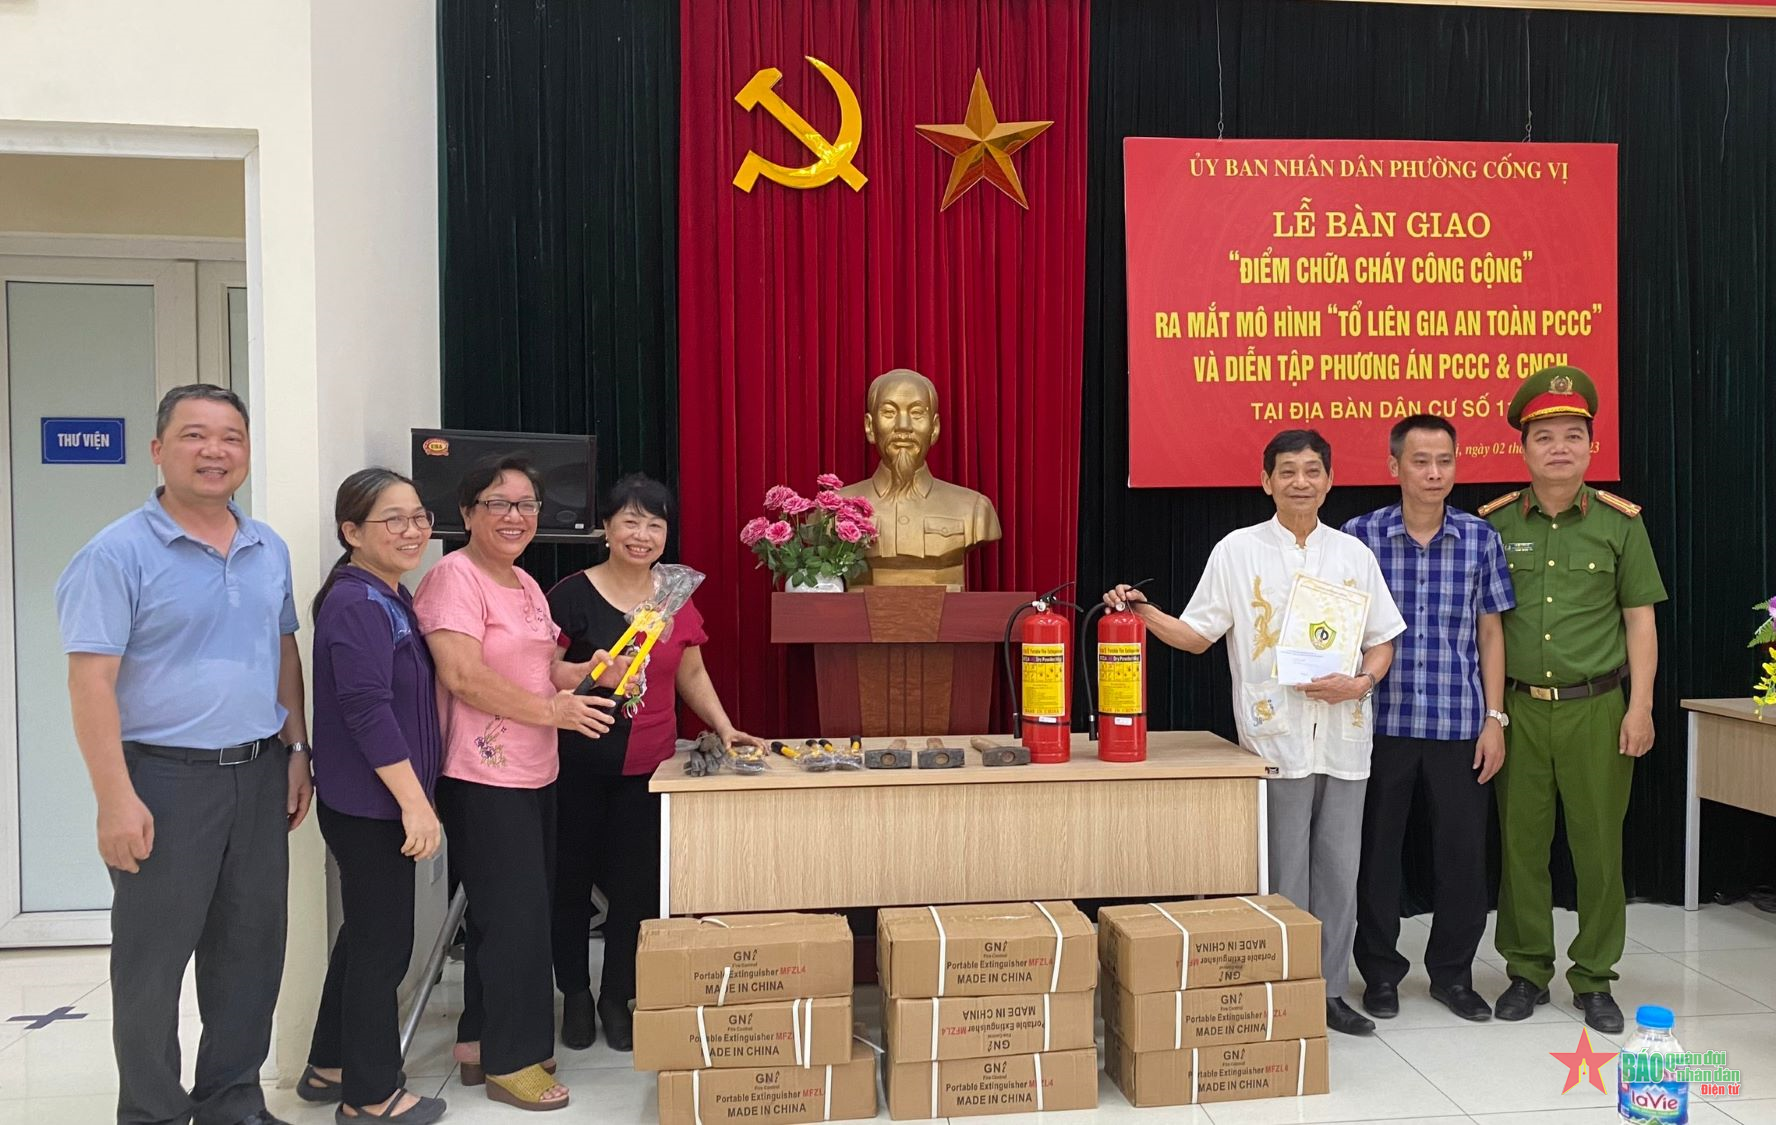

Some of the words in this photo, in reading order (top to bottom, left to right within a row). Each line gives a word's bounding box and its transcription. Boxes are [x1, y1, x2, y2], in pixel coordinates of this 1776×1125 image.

[1190, 153, 1219, 176] ỦY
[1225, 159, 1268, 176] BAN
[1274, 154, 1334, 176] NHÂN
[1340, 154, 1384, 176] DÂN
[1390, 156, 1476, 178] PHƯỜNG
[1483, 153, 1541, 178] CỐNG
[1548, 162, 1568, 184] VỊ
[1273, 197, 1316, 237] LỄ
[1326, 204, 1396, 237] BÀN
[1407, 212, 1490, 238] GIAO
[1296, 252, 1349, 283] CHỮA
[1355, 252, 1405, 283] CHÁY
[1412, 252, 1464, 283] CÔNG
[1156, 312, 1181, 338] RA
[1188, 302, 1230, 338] MẮT
[1236, 306, 1267, 338] MÔ
[1274, 305, 1321, 337] HÌNH
[1368, 305, 1410, 336] LIÊN
[1416, 310, 1448, 336] GIA
[1454, 310, 1480, 336] AN
[1487, 305, 1536, 336] TOÀN
[1194, 350, 1219, 382] VÀ
[1225, 346, 1271, 381] DIỄN
[1278, 350, 1314, 387] TẬP
[1320, 352, 1399, 380] PHƯƠNG
[1406, 348, 1433, 379] ÁN
[1439, 353, 1490, 379] PCCC
[1496, 353, 1510, 380] &
[1251, 403, 1283, 424] TẠI
[1290, 402, 1324, 423] ĐỊA
[1330, 397, 1372, 418] BÀN
[1380, 396, 1421, 418] DÂN
[1429, 398, 1457, 417] CƯ
[1462, 393, 1490, 417] SỐ
[58, 432, 81, 447] THƯ
[83, 431, 109, 450] VIỆN
[1466, 443, 1490, 458] ngày
[1492, 442, 1505, 455] 02
[1196, 942, 1225, 953] CHINA
[1228, 941, 1237, 951] IN
[1240, 940, 1266, 950] MADE
[947, 961, 978, 970] Portable
[980, 959, 1026, 969] Extinguisher
[1201, 955, 1245, 964] Extinguisher
[729, 968, 778, 979] Extinguisher
[958, 974, 986, 984] MADE
[988, 973, 998, 983] IN
[1001, 972, 1032, 982] CHINA
[706, 984, 735, 994] MAE
[738, 983, 749, 993] IN
[751, 981, 784, 992] CHINA
[963, 1009, 993, 1020] CHINA
[995, 1008, 1006, 1018] IN
[1008, 1006, 1036, 1016] MADE
[1186, 1014, 1216, 1023] Portable
[1218, 1012, 1262, 1021] Extinguisher
[968, 1022, 1014, 1033] Extinguisher
[1196, 1027, 1223, 1036] MADE
[1225, 1026, 1235, 1035] IN
[1237, 1024, 1266, 1033] CHINA
[724, 1032, 774, 1044] Extinguisher
[733, 1047, 744, 1056] IN
[747, 1046, 780, 1056] CHINA
[1219, 1067, 1264, 1077] Extinguisher
[946, 1083, 978, 1092] Portable
[980, 1081, 1027, 1092] Extinguisher
[1198, 1082, 1226, 1092] MADE
[1227, 1081, 1237, 1090] IN
[1239, 1079, 1269, 1089] CHINA
[716, 1094, 749, 1103] Portable
[751, 1091, 800, 1101] Extinguisher
[802, 1088, 824, 1097] MFZL
[957, 1095, 986, 1105] MADE
[988, 1095, 998, 1104] IN
[1000, 1093, 1032, 1104] CHINA
[728, 1106, 758, 1117] MADE
[760, 1105, 771, 1115] IN
[774, 1103, 806, 1114] CHINA
